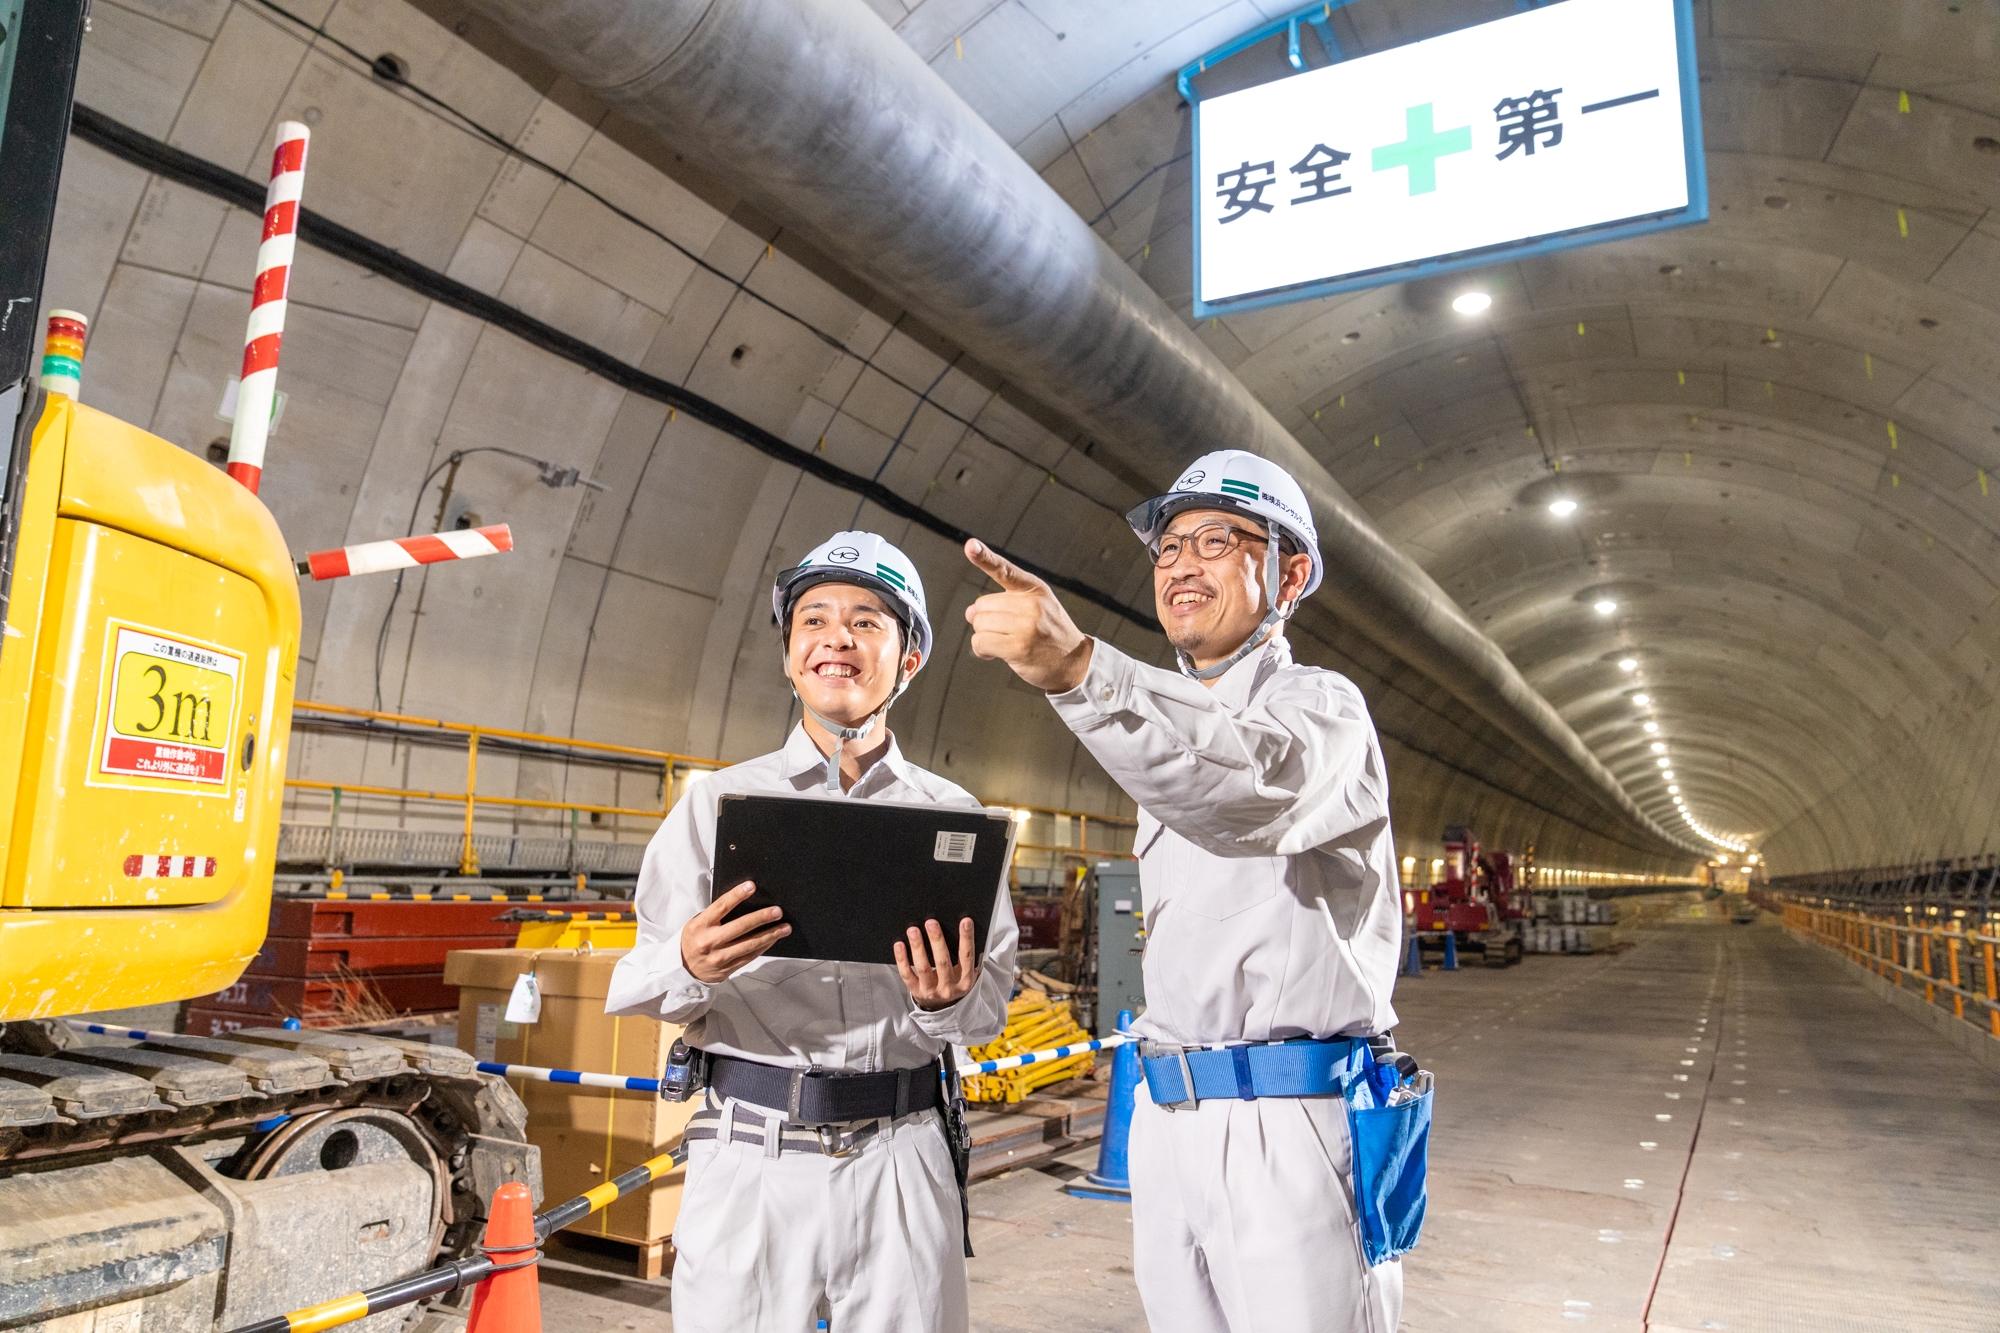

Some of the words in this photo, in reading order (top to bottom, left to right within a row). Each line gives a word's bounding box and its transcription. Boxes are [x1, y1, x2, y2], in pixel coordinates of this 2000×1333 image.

[1216, 143, 1352, 225] 安全
[1493, 87, 1660, 161] 第一
[136, 664, 211, 741] 3m
